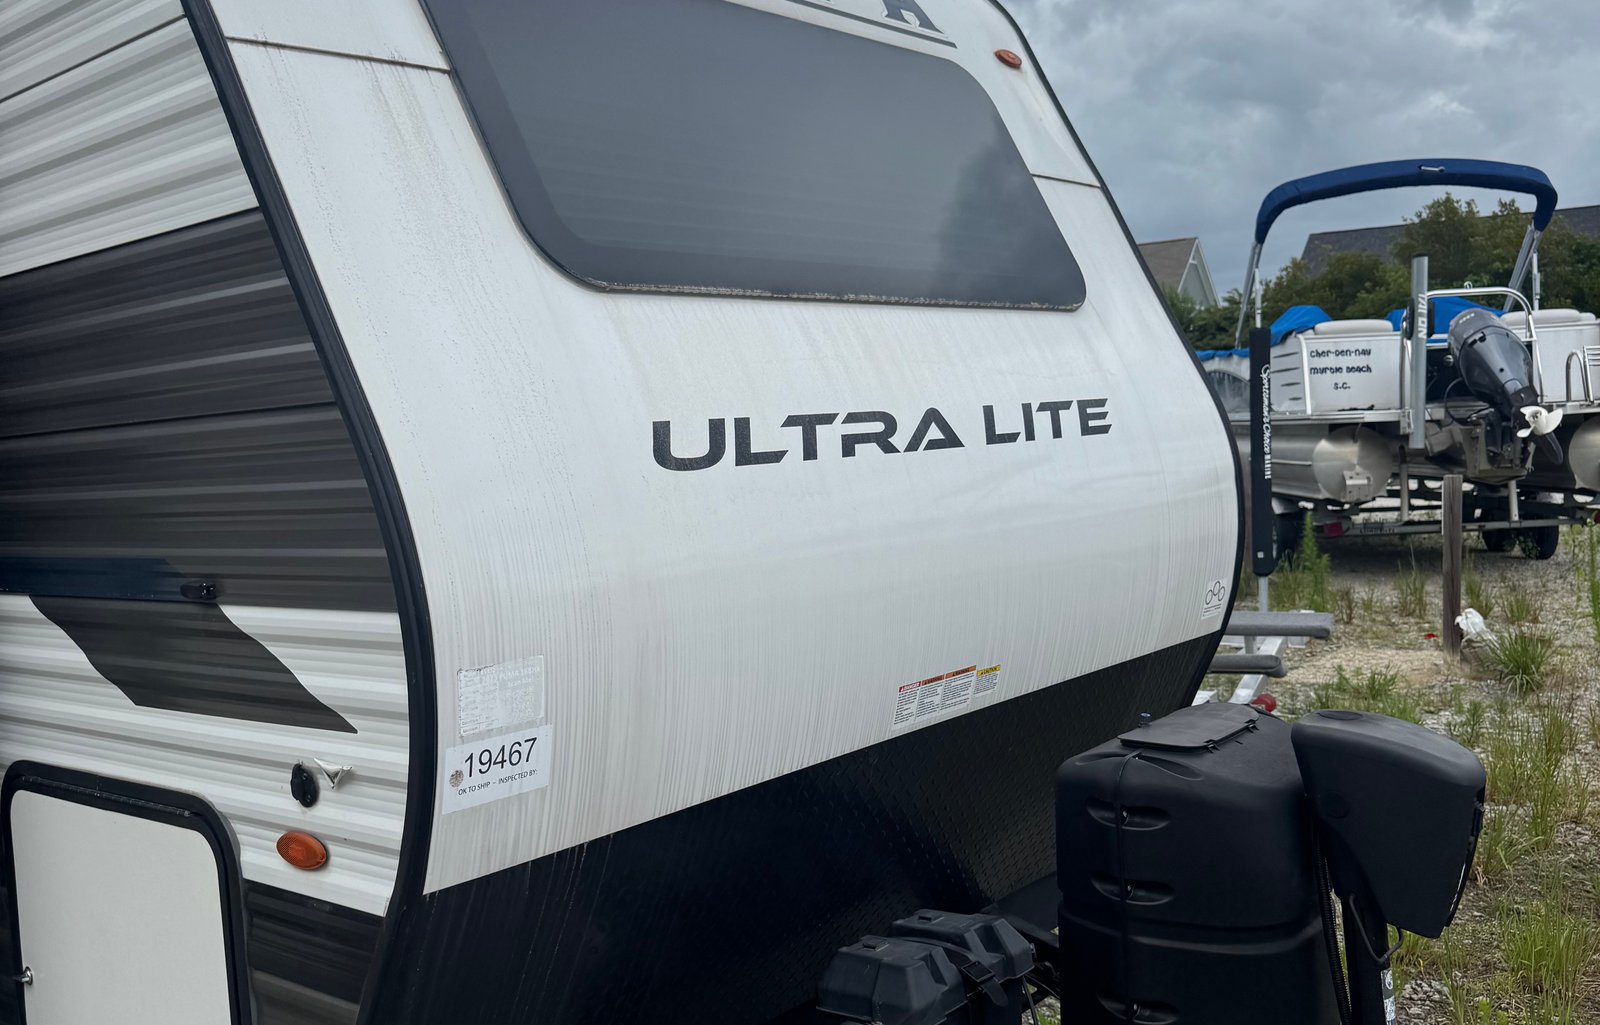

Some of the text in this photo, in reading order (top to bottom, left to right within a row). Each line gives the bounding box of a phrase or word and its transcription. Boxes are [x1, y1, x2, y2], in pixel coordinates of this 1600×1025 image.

[652, 398, 1113, 471] ULTRA LITE
[464, 737, 537, 778] 19467
[458, 787, 467, 796] OK
[468, 784, 477, 793] TO
[477, 781, 491, 791] SHIP
[498, 771, 528, 785] INSPECTED
